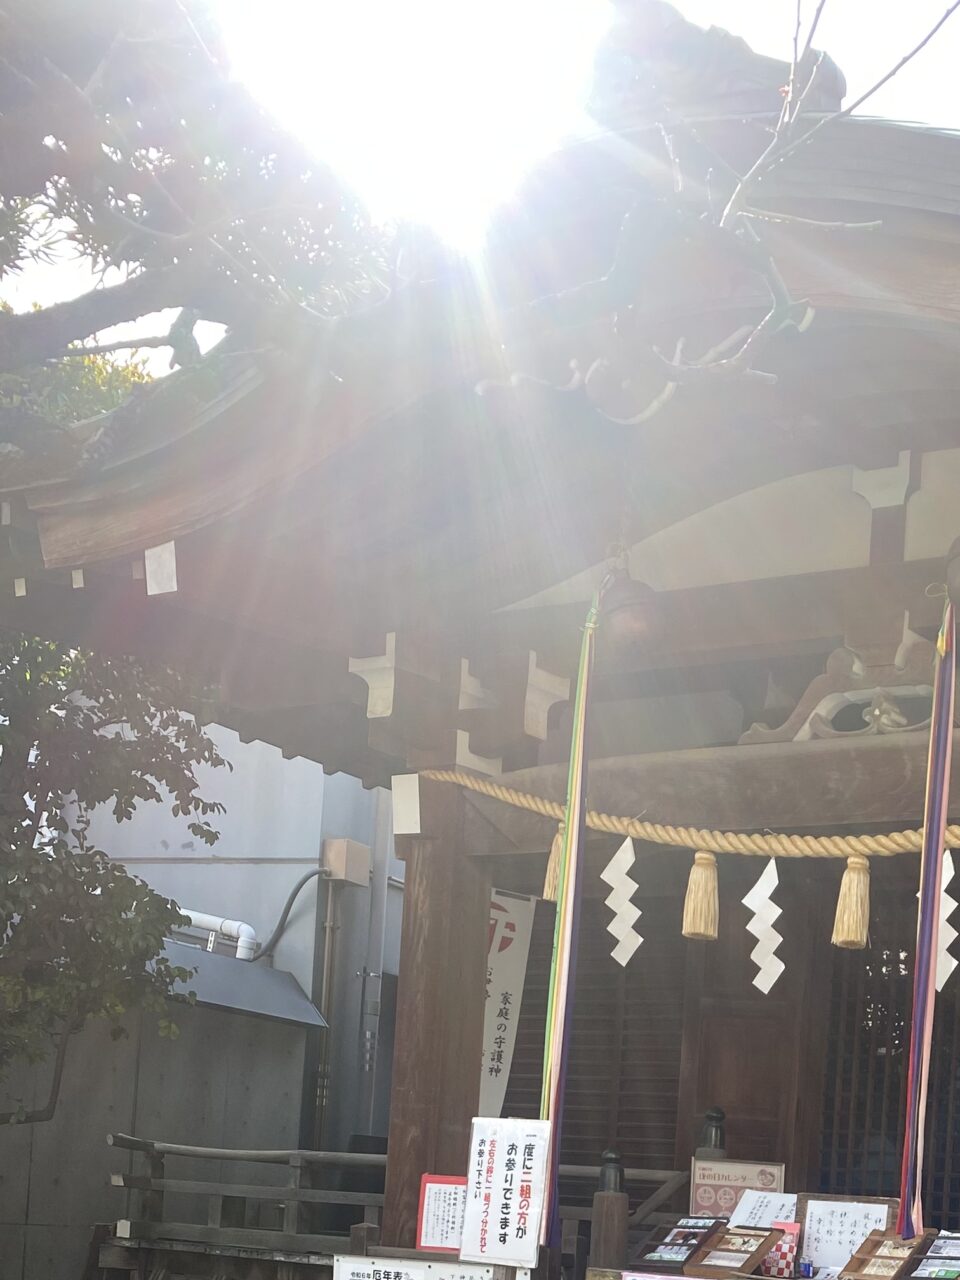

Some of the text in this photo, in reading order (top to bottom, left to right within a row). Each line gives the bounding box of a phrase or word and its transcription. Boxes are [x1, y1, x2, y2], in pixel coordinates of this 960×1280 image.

[474, 1138, 487, 1199] お参り下さい
[498, 1142, 518, 1245] お参りできます
[516, 1134, 537, 1239] 一度に二組の方が
